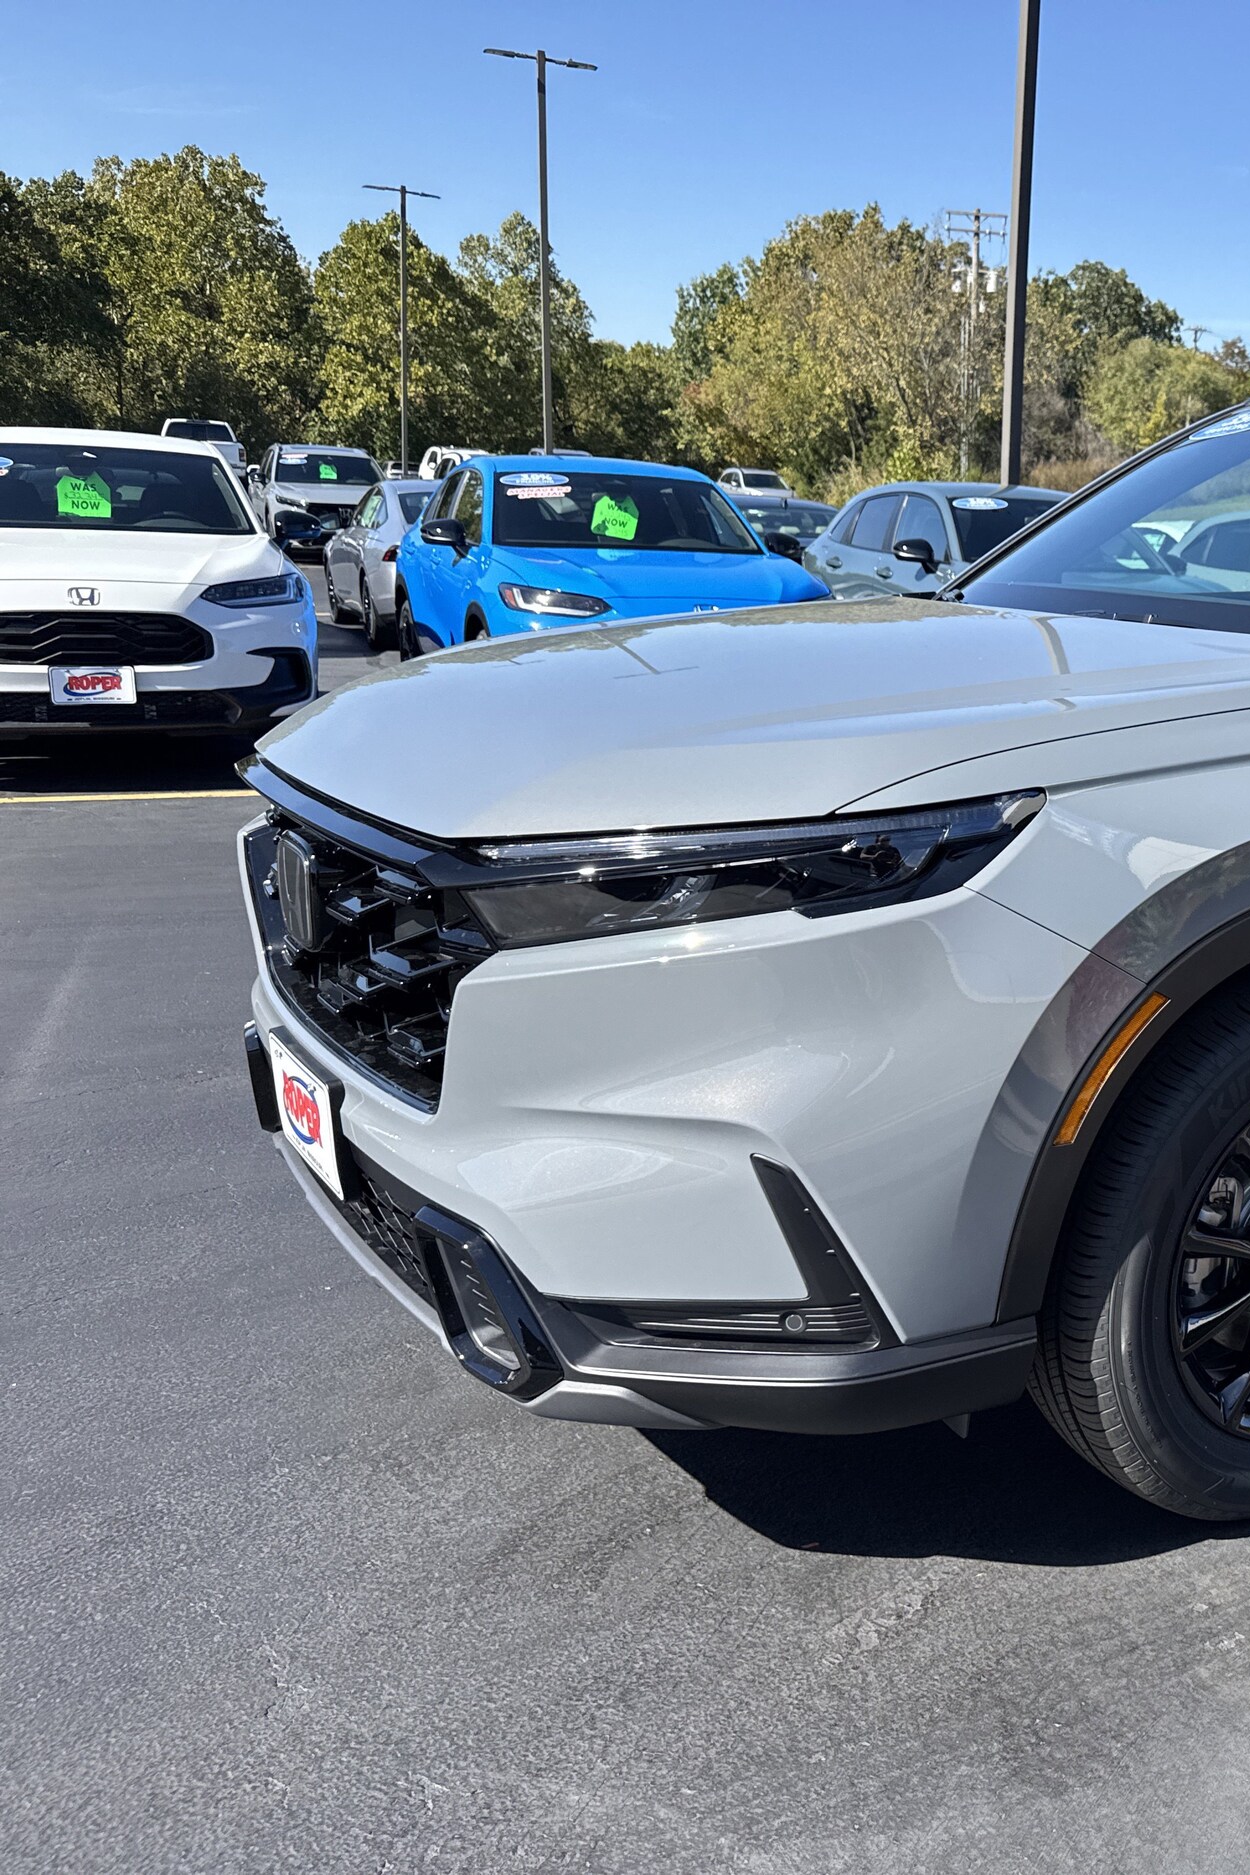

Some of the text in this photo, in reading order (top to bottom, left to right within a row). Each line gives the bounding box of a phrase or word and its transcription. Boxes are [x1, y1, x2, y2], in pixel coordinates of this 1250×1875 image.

[70, 482, 97, 492] WAS
[71, 500, 101, 511] NOW
[602, 516, 629, 529] NOW
[67, 675, 122, 691] ROPER
[282, 1069, 324, 1149] ROPER
